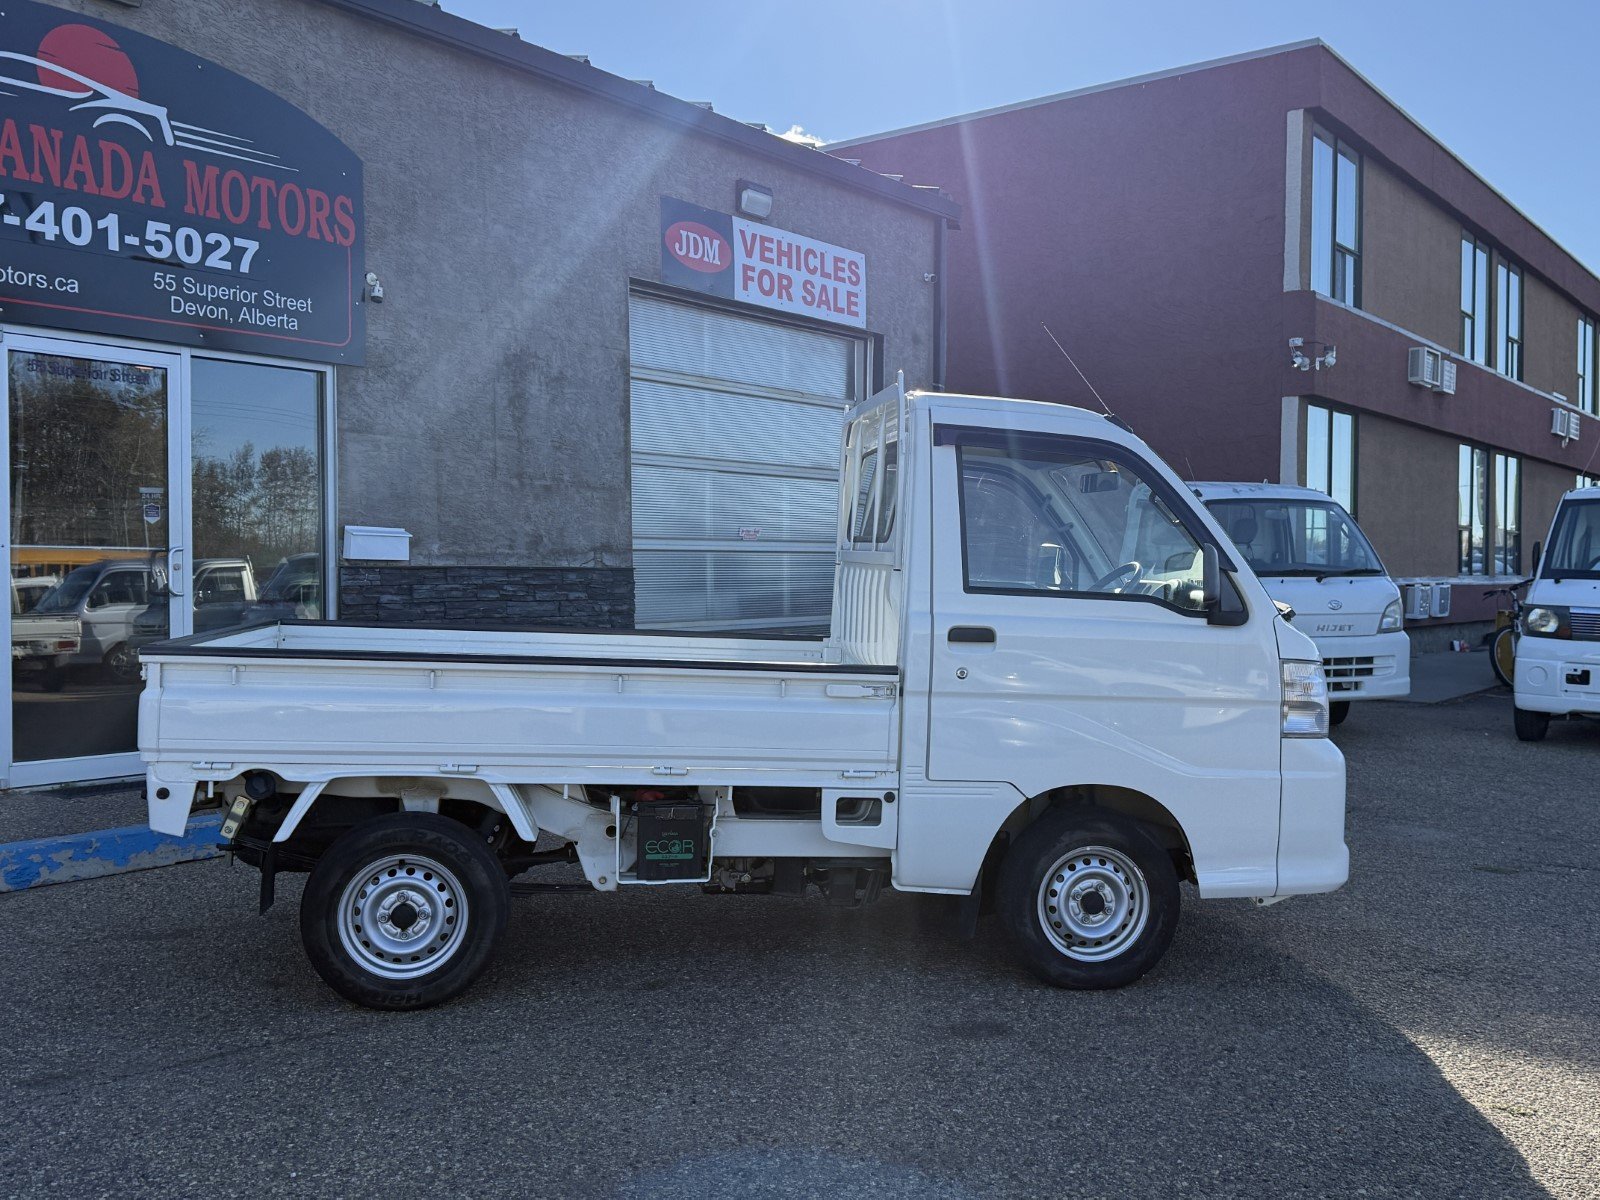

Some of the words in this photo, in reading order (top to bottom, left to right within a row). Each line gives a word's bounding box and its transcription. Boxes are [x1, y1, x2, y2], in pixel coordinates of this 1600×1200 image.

[182, 159, 357, 247] MOTORS
[0, 193, 260, 274] -401-5027
[674, 229, 721, 265] JDM
[738, 228, 861, 287] VEHICLES
[153, 271, 177, 292] 55
[182, 276, 258, 304] Superior
[262, 289, 313, 314] Street
[170, 295, 234, 324] Devon,
[238, 306, 299, 331] Alberta
[741, 263, 794, 302] FOR
[801, 279, 860, 318] SALE
[1315, 623, 1355, 632] HIJET
